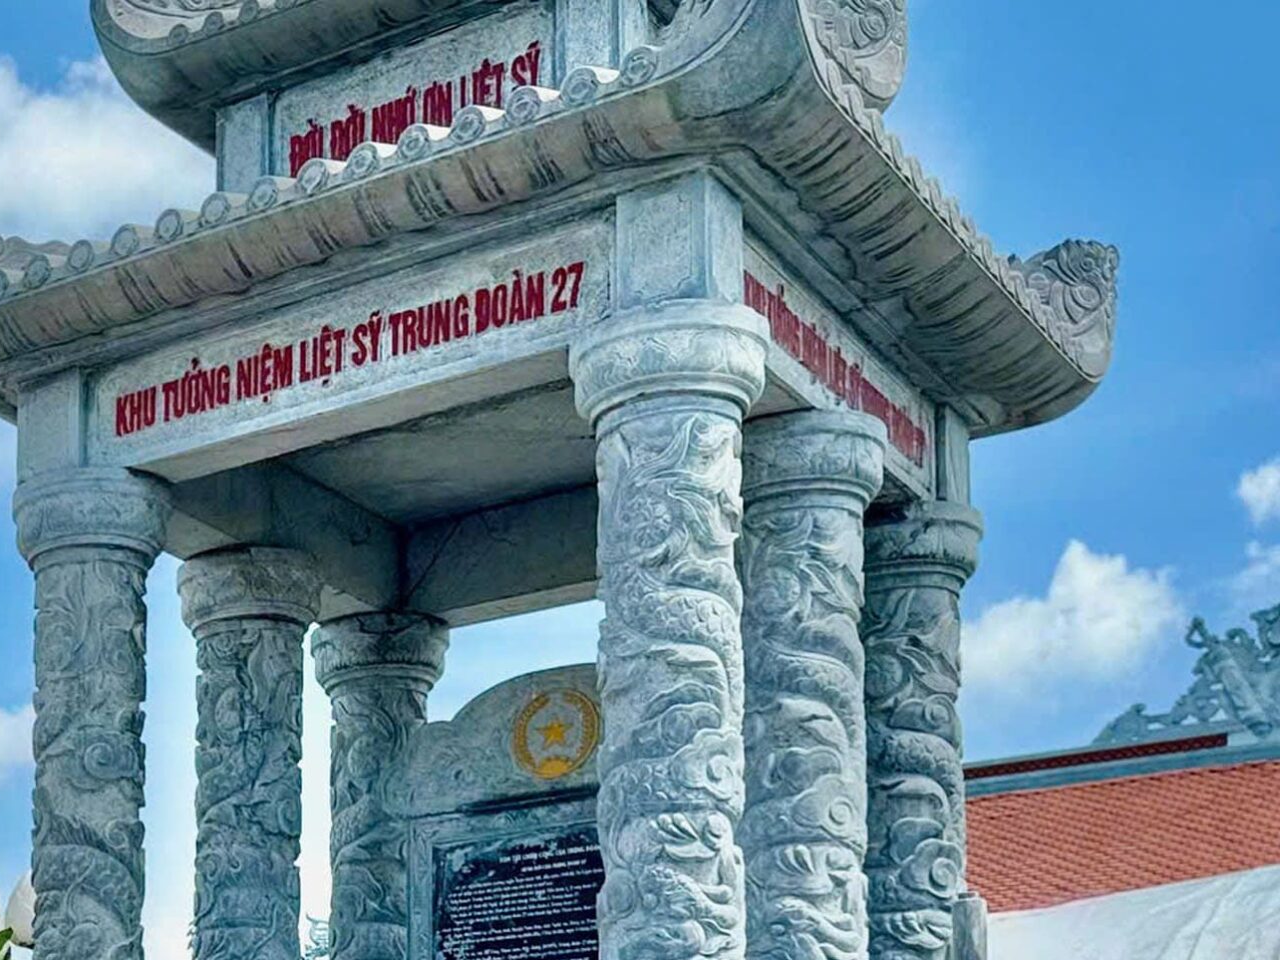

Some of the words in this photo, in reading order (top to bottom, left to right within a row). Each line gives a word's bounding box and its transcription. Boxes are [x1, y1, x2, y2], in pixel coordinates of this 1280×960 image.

[422, 80, 453, 128] ƠN
[115, 386, 157, 437] KHU
[161, 356, 231, 422] TƯỞNG
[236, 342, 294, 404] NIỆM
[298, 323, 346, 387] LIỆT
[351, 310, 382, 366] SỸ
[388, 293, 470, 356] TRUNG
[474, 269, 546, 335] ĐOÀN
[550, 261, 586, 314] 27
